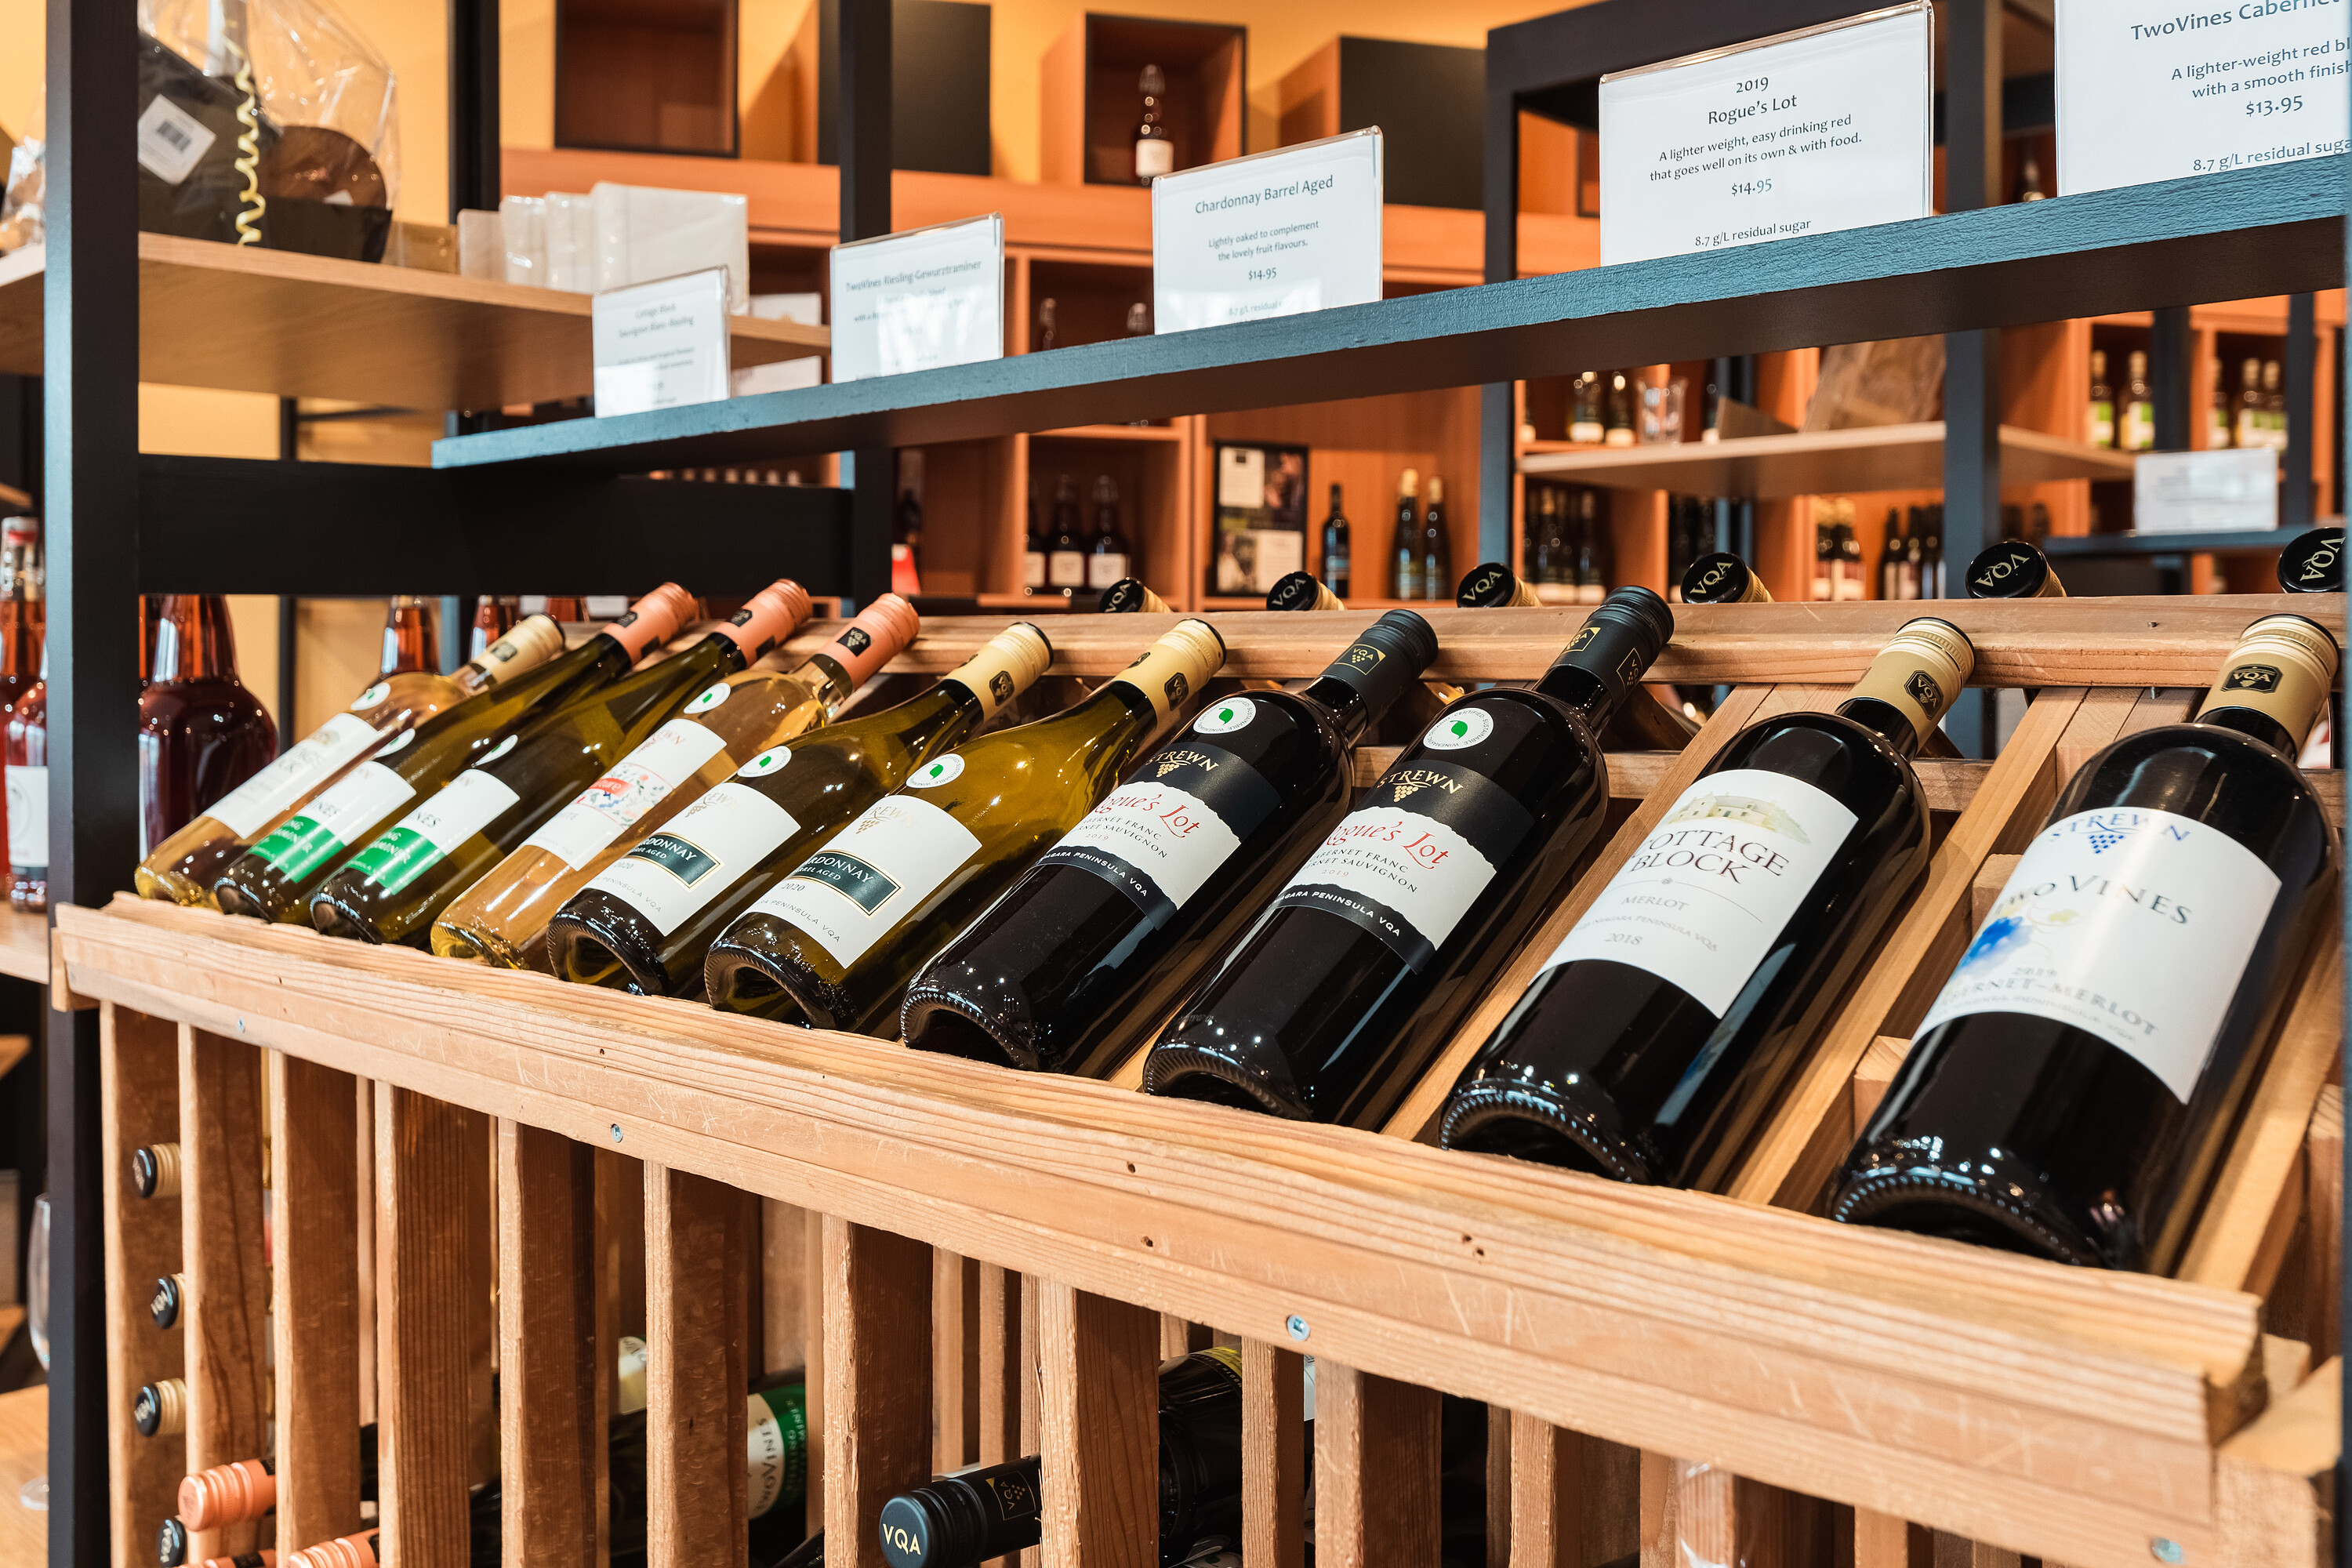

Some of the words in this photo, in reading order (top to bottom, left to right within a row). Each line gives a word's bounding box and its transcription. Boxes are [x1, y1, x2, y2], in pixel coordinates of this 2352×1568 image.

[2131, 10, 2233, 40] TwoVines
[2239, 0, 2340, 20] Cabern
[2171, 67, 2183, 81] A
[2187, 48, 2299, 80] lighter-weight
[2303, 40, 2330, 57] red
[1736, 77, 1769, 93] 2019
[2192, 82, 2227, 98] with
[2231, 82, 2240, 93] a
[2245, 69, 2304, 89] smooth
[1708, 100, 1767, 125] Rogue's
[1773, 95, 1797, 111] Lot
[2245, 95, 2303, 118] $13.95
[1659, 151, 1668, 162] A
[1670, 144, 1705, 162] lighter
[1708, 136, 1749, 152] weight,
[1751, 131, 1777, 143] easy
[1780, 120, 1828, 138] drinking
[1831, 114, 1852, 127] red
[1650, 169, 1671, 181] that
[1674, 165, 1700, 180] goes
[1702, 158, 1725, 171] well
[1728, 157, 1742, 167] on
[1744, 152, 1758, 164] its
[1761, 150, 1785, 161] own
[1788, 144, 1797, 154] &
[1800, 139, 1827, 153] with
[1830, 132, 1862, 147] food.
[2193, 159, 2215, 172] 8.7
[2220, 153, 2243, 171] g/L
[2247, 142, 2310, 163] residual
[1195, 193, 1261, 214] Chardonnay
[1265, 181, 1299, 200] Barrel
[1302, 175, 1333, 195] Aged
[1731, 178, 1772, 196] $14.95
[1208, 236, 1234, 249] Lightly
[1236, 230, 1258, 243] oaked
[1270, 220, 1319, 237] complement
[1695, 236, 1710, 246] 8.7
[1712, 231, 1730, 247] g/L
[1732, 223, 1776, 240] residual
[1779, 220, 1811, 234] sugar
[1218, 251, 1230, 261] the
[1232, 247, 1254, 258] lovely
[1256, 243, 1272, 255] fruit
[1275, 239, 1308, 251] flavours.
[884, 271, 913, 285] Riesling
[1248, 267, 1277, 281] $14.95
[1975, 552, 2030, 589] VQA
[2300, 536, 2347, 582] VQA
[1272, 577, 1307, 607] VQA
[1462, 570, 1504, 601] VQA
[1689, 561, 1734, 596] VQA
[1105, 582, 1131, 613] VQA
[1352, 646, 1374, 661] VQA
[2233, 670, 2271, 684] VQA
[1145, 750, 1219, 772] STREWN
[1377, 769, 1464, 794] STREWN
[1125, 819, 1163, 840] FRANC
[1159, 803, 1200, 838] Lot
[2049, 812, 2193, 843] STREWN
[643, 837, 697, 862] RDONNAY
[1085, 833, 1109, 841] 2019
[1103, 824, 1167, 858] SAUVIGNON
[1402, 830, 1450, 869] Lot
[647, 848, 667, 859] AGED
[1366, 851, 1409, 873] FRANC
[1629, 849, 1751, 885] BLOCK
[781, 882, 806, 892] 2020
[816, 869, 841, 881] AGED
[1073, 851, 1126, 878] PENINSULA
[1129, 877, 1148, 897] VQA
[1321, 869, 1350, 877] 2019
[1341, 858, 1418, 893] SAUVIGNON
[603, 877, 643, 898] PENINSULA
[645, 896, 662, 913] VQA
[1621, 895, 1690, 911] MERLOT
[771, 900, 818, 925] PENINSULA
[822, 924, 841, 942] VQA
[1278, 891, 1308, 900] AGARA
[1312, 891, 1374, 918] PENINSULA
[1378, 916, 1400, 937] VQA
[1604, 932, 1643, 946] 2018
[1635, 915, 1691, 937] PENINSULA
[1695, 932, 1718, 953] VQA
[1000, 1478, 1016, 1512] VQA
[882, 1522, 921, 1556] VQA
